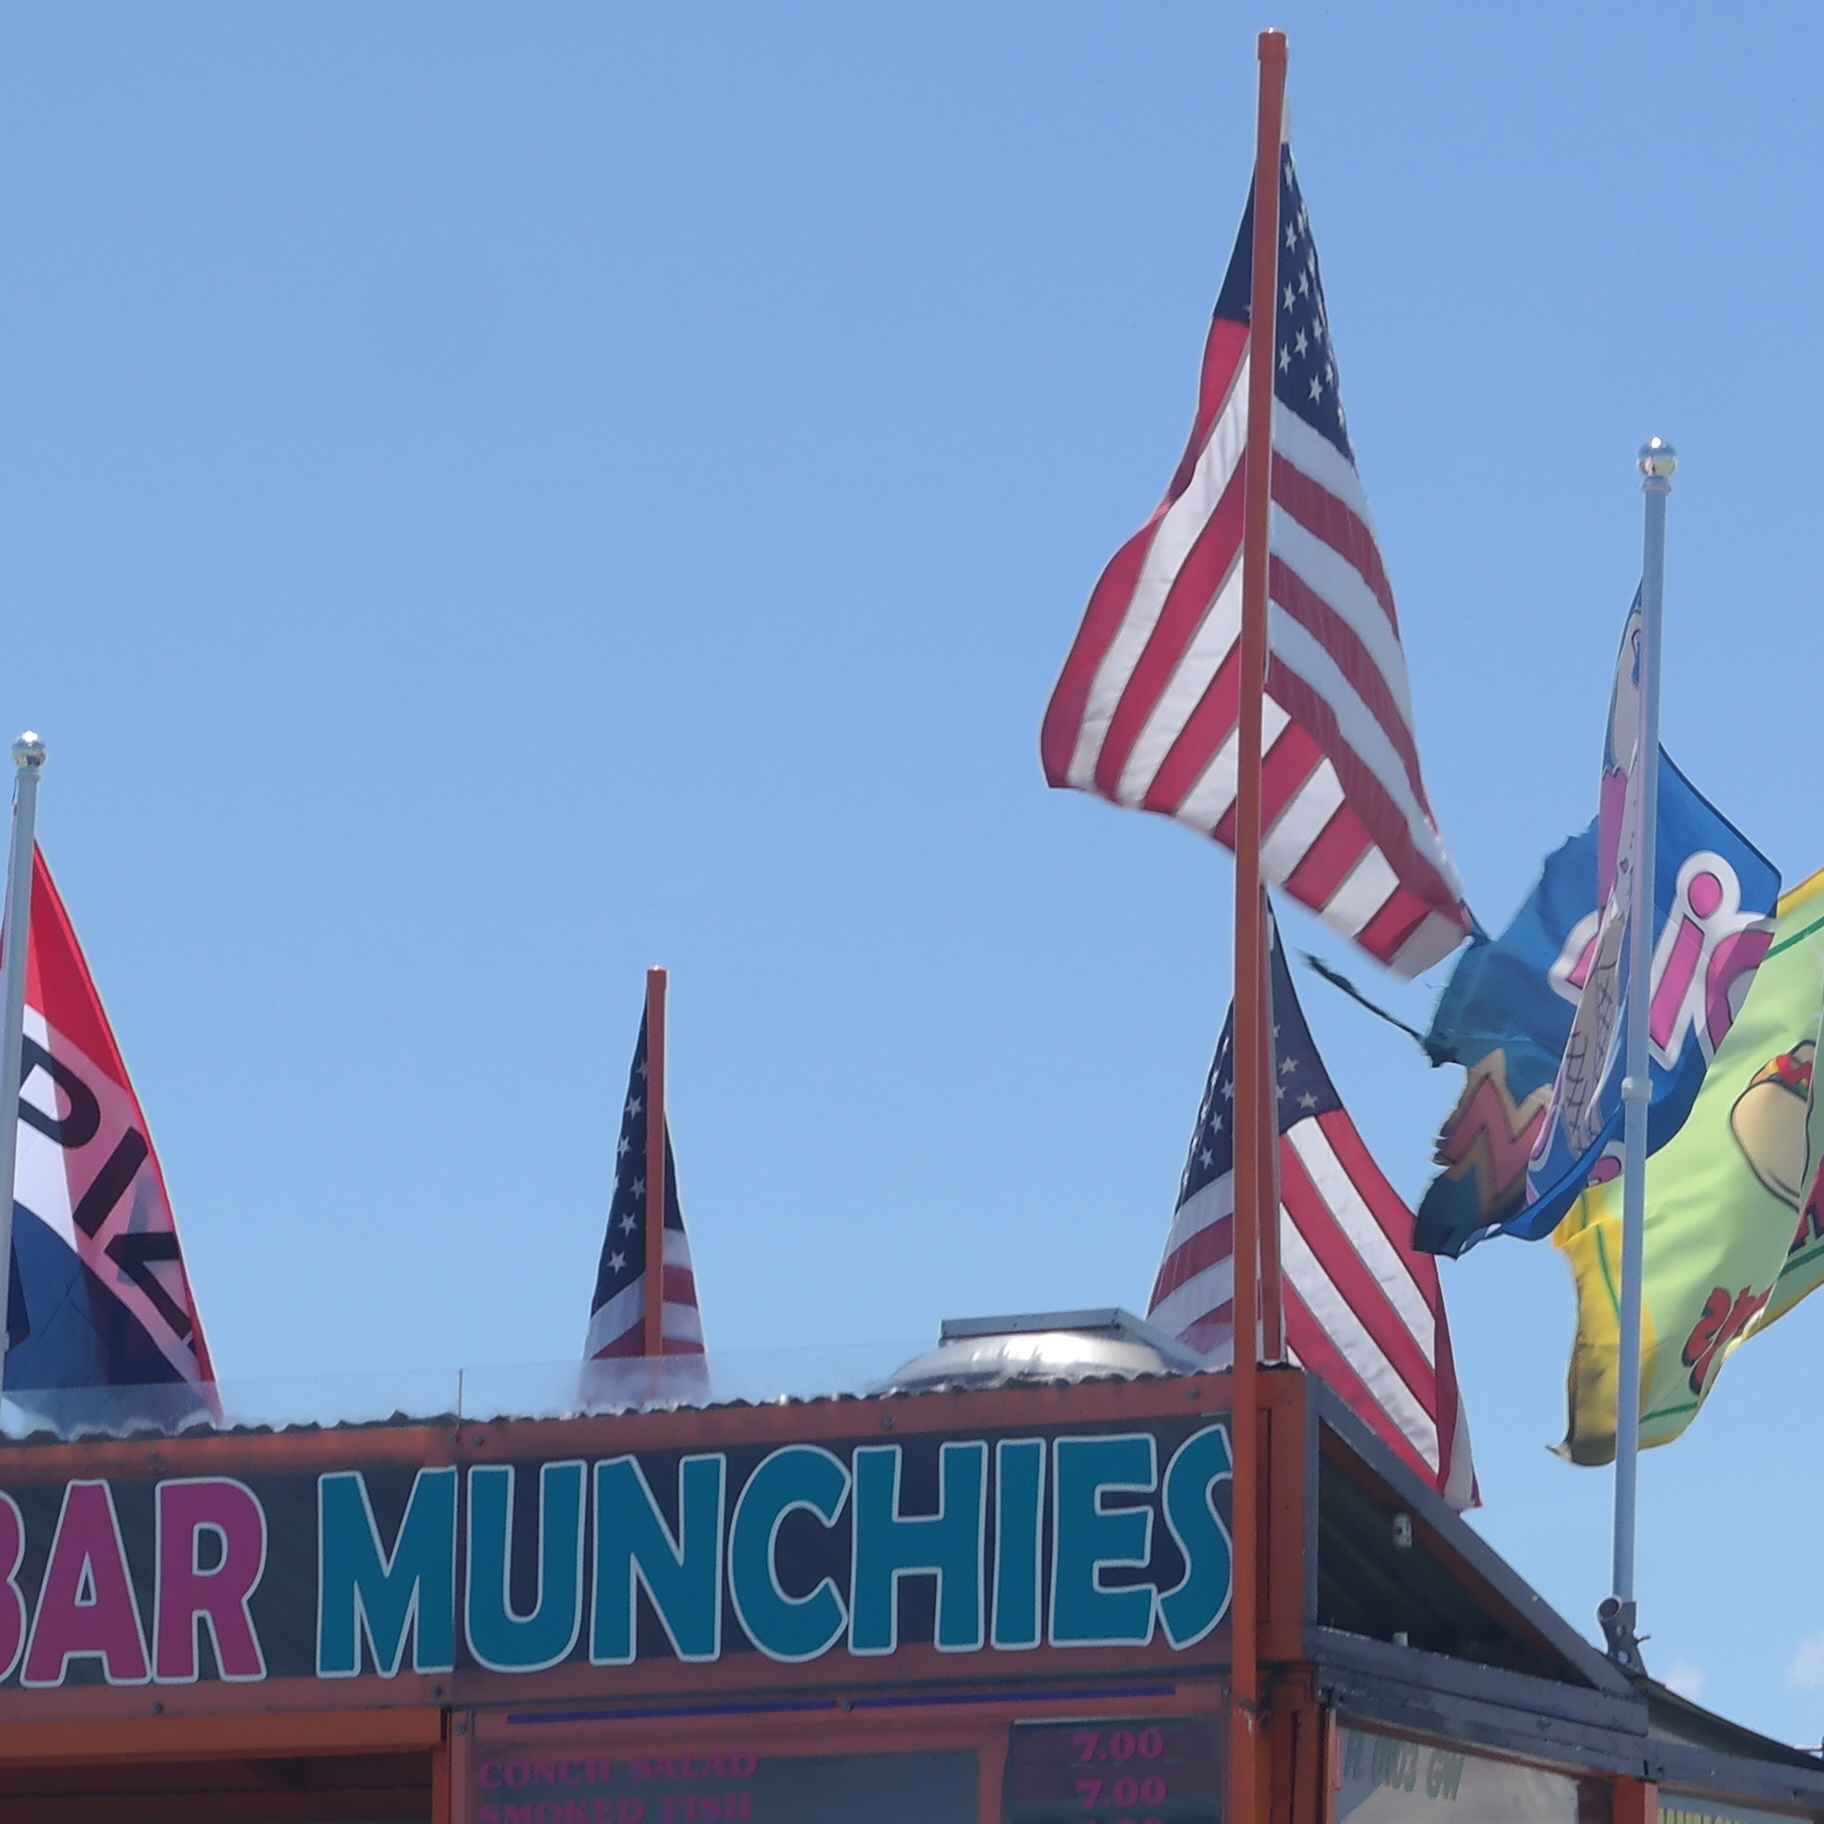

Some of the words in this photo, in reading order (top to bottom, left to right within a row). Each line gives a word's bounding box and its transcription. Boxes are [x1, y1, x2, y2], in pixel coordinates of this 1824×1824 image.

[315, 1423, 1233, 1680] MUNCHIES
[479, 1756, 614, 1790] CONCH
[630, 1750, 760, 1784] SALAD
[1073, 1728, 1164, 1763] 7.00
[662, 1791, 755, 1824] FISH
[1075, 1777, 1168, 1811] 7.00
